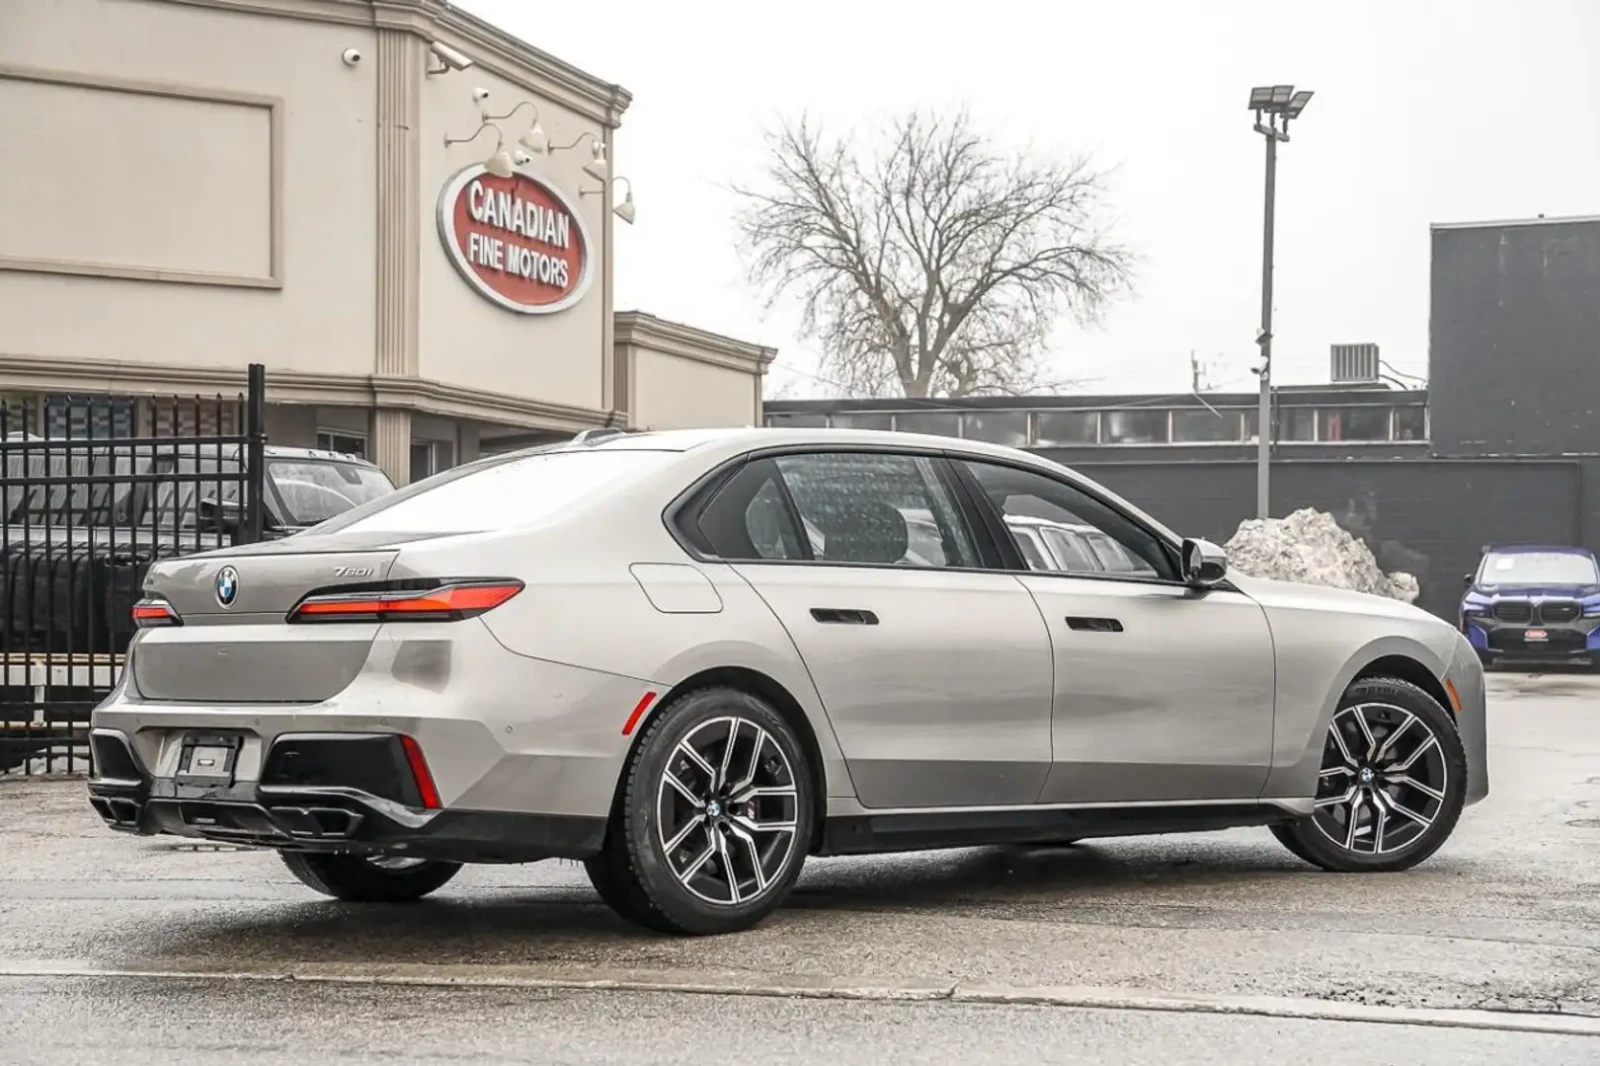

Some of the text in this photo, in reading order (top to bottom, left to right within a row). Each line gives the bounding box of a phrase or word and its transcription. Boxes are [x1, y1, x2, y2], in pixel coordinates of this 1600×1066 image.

[469, 179, 570, 249] CANADIAN
[469, 232, 569, 289] FINE MOTORS
